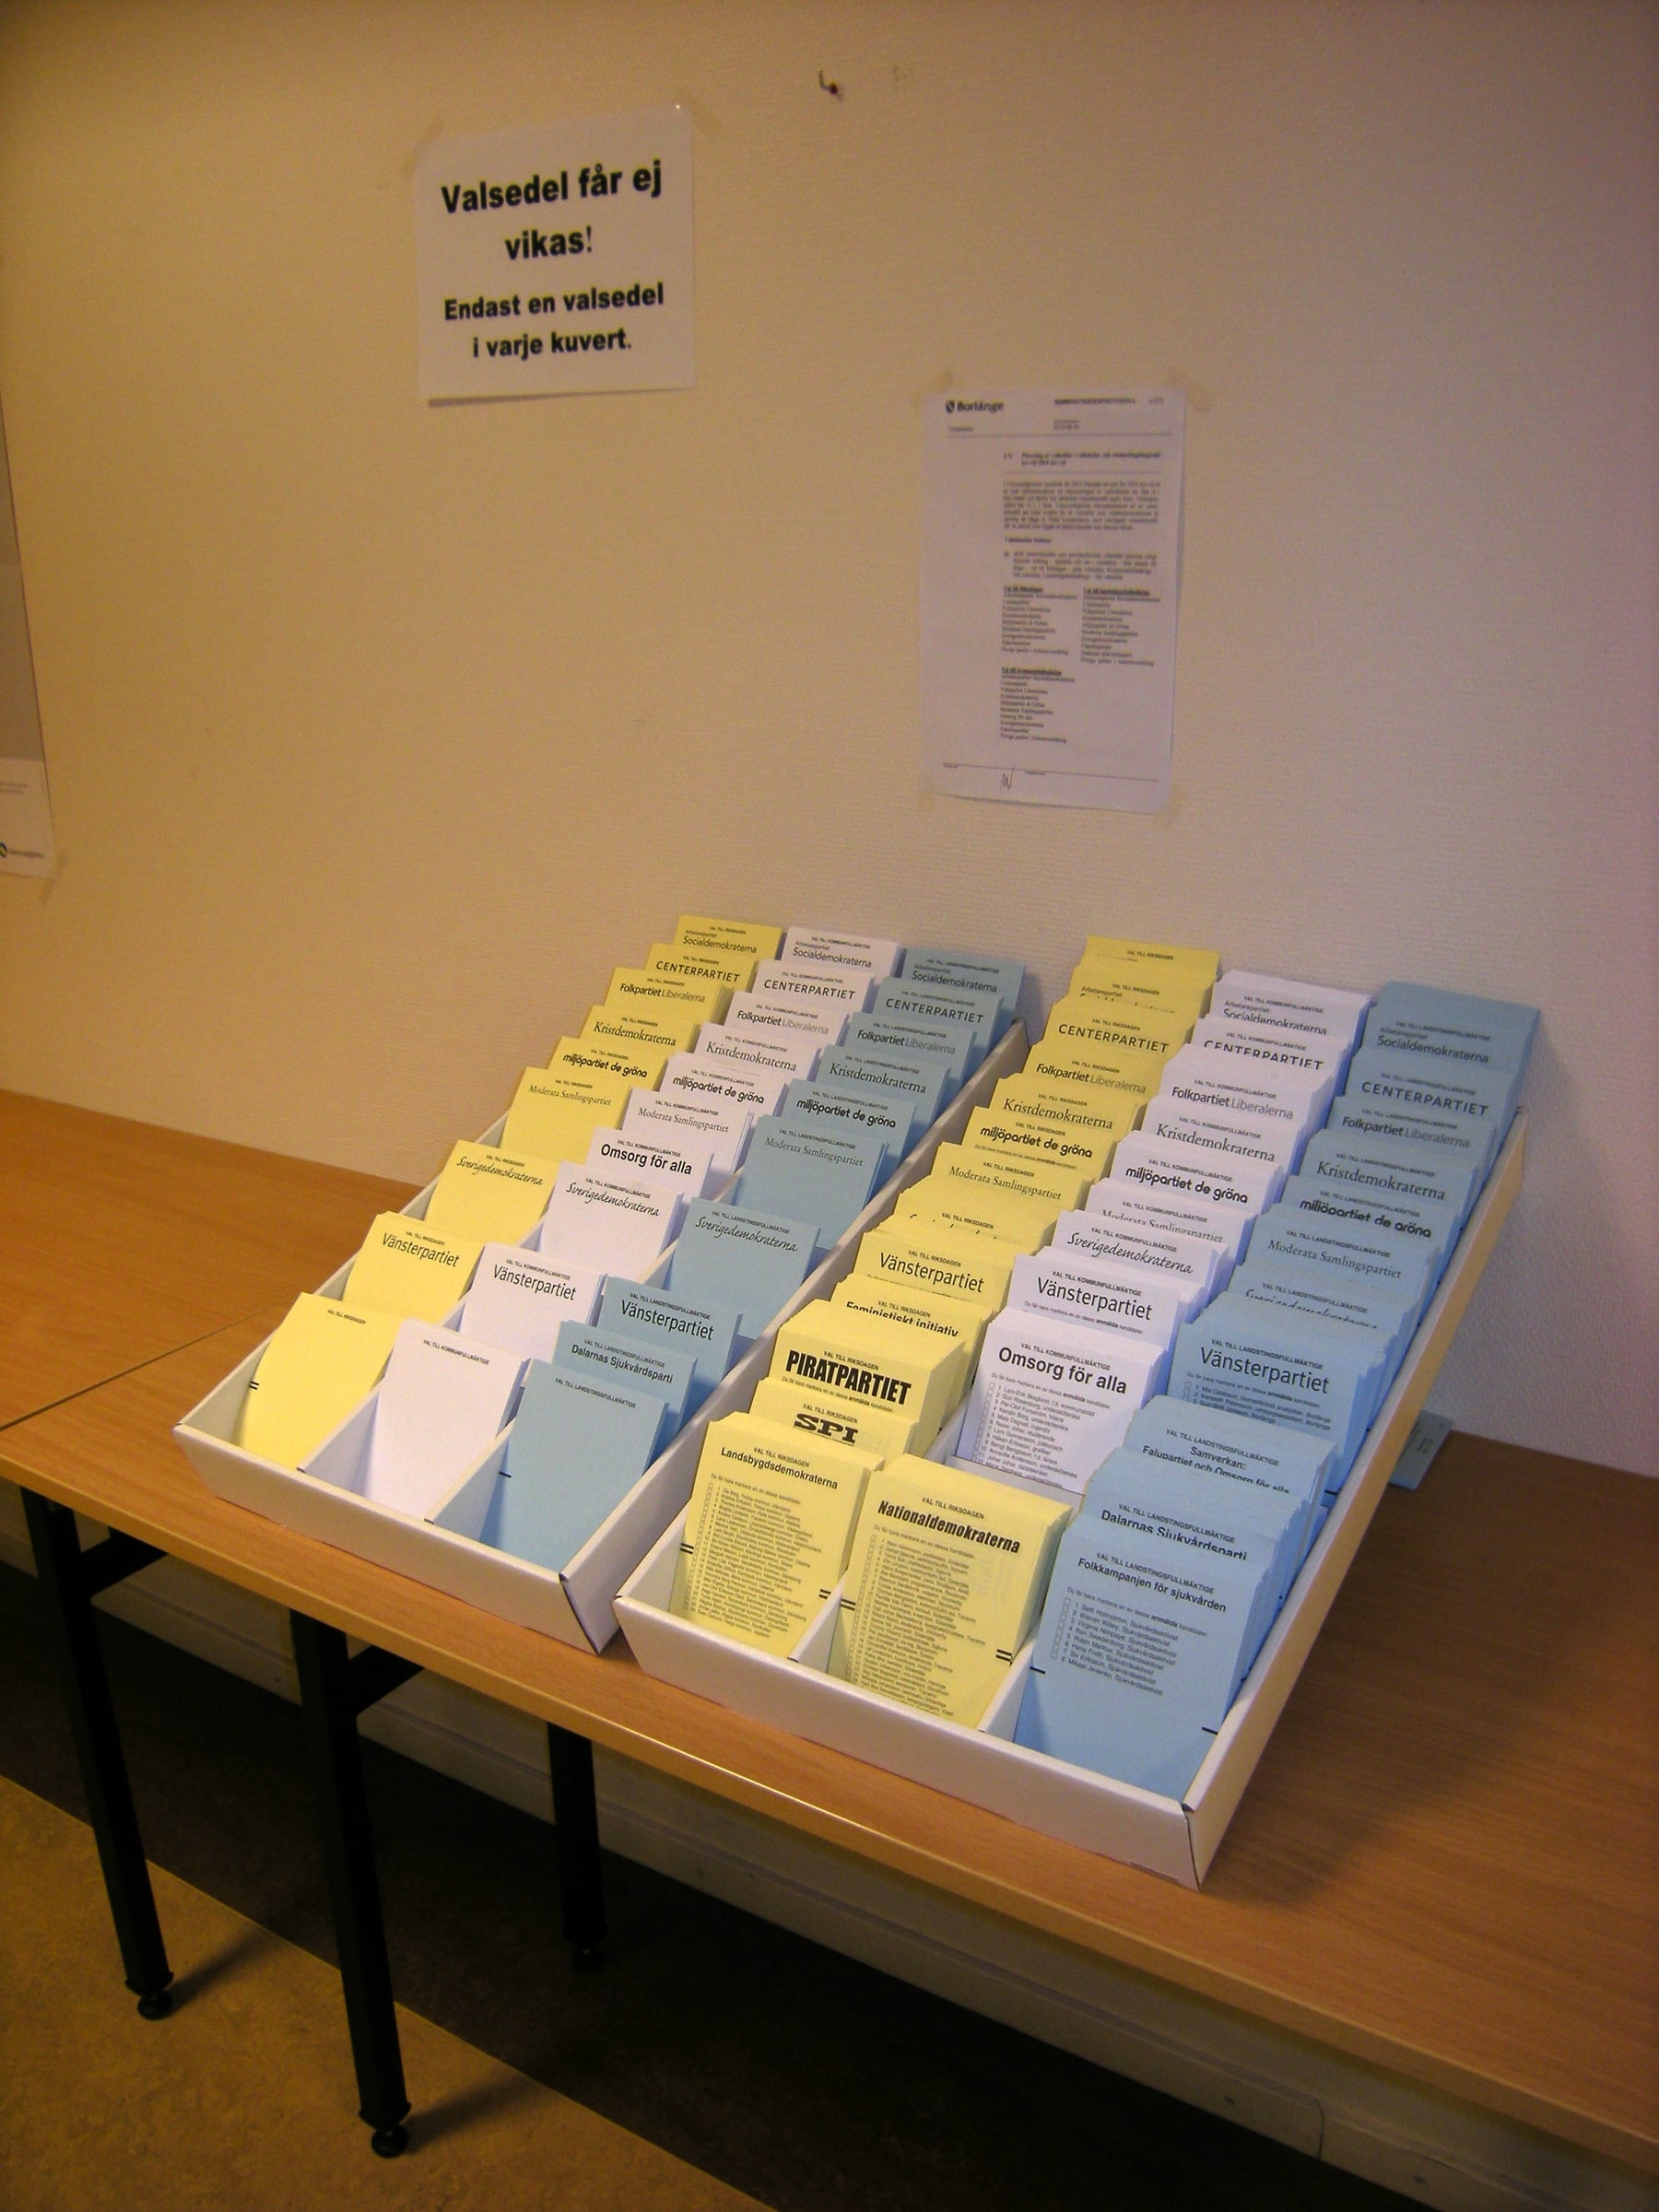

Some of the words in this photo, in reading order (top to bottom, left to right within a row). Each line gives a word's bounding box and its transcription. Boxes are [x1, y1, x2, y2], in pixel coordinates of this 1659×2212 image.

[441, 171, 569, 214] Valsedel
[579, 163, 622, 197] får
[632, 159, 662, 197] ej
[505, 226, 592, 260] vikas!
[444, 295, 520, 320] Endast
[529, 296, 555, 313] en
[563, 282, 664, 311] valsedel
[473, 337, 478, 357] i
[487, 334, 543, 360] varje
[551, 327, 631, 353] kuvert.
[683, 935, 757, 954] Socialdemokraterna
[793, 947, 872, 968] Socialdemokraterna
[655, 960, 740, 982] CENTERPARTIET
[912, 971, 997, 993] Socialdemokraterna
[764, 979, 855, 1000] CENTERPARTIET
[886, 998, 984, 1023] CENTERPARTIET
[594, 1021, 677, 1046] Kristdemokraterna
[1058, 1023, 1170, 1053] CENTERPARTIET
[1377, 1034, 1489, 1064] Socialdemokraterna
[610, 1061, 621, 1072] de
[622, 1066, 648, 1077] gröna
[706, 1041, 796, 1072] Kristdemokraterna
[830, 1063, 927, 1094] Kristdemokraterna
[529, 1084, 559, 1097] Moderata
[560, 1090, 611, 1106] Samlingspartiet
[724, 1086, 736, 1098] de
[737, 1090, 765, 1104] gröna
[1361, 1081, 1488, 1116] CENTERPARTIET
[638, 1107, 672, 1122] Moderata
[674, 1113, 729, 1134] Samlingspartiet
[796, 1098, 851, 1118] miljöpartiet
[853, 1109, 865, 1122] de
[867, 1114, 896, 1128] gröna
[1003, 1098, 1113, 1130] Kristdemokraterna
[765, 1137, 801, 1153] Moderata
[803, 1146, 863, 1167] Samlingspartiet
[981, 1126, 1041, 1147] miljöpartiet
[1044, 1138, 1058, 1150] de
[1060, 1143, 1092, 1158] gröna
[1157, 1123, 1275, 1163] Kristdemokraterna
[457, 1157, 544, 1186] Sverigedemokraterna
[601, 1143, 647, 1167] Omsorg
[651, 1154, 665, 1170] för
[670, 1161, 692, 1176] alla
[949, 1166, 991, 1183] Moderata
[993, 1175, 1061, 1200] Samlingspartiet
[1125, 1166, 1192, 1191] miljöpartiet
[1194, 1182, 1211, 1195] de
[1213, 1187, 1248, 1204] gröna
[1317, 1160, 1444, 1201] Kristdemokraterna
[566, 1182, 660, 1217] Sverigedemokraterna
[695, 1216, 798, 1252] Sverigedemokraterna
[1374, 1215, 1391, 1229] de
[382, 1232, 460, 1267] Vänsterpartiet
[1067, 1232, 1194, 1275] Sverigedemokraterna
[1268, 1240, 1317, 1261] Moderata
[1320, 1251, 1402, 1279] Samlingspartiet
[493, 1264, 577, 1301] Vänsterpartiet
[880, 1252, 985, 1293] Vänsterpartiet
[1038, 1277, 1152, 1321] Vänsterpartiet
[621, 1299, 714, 1340] Vänsterpartiet
[571, 1344, 608, 1364] Dalarnas
[610, 1357, 673, 1383] Sjukvårdsparti
[785, 1349, 912, 1405] PIRATPARTIET
[998, 1347, 1064, 1380] Omsorg
[1068, 1365, 1092, 1384] för
[1096, 1374, 1126, 1394] alla
[1200, 1347, 1329, 1394] Vänsterpartiet
[794, 1413, 858, 1443] SPI
[1165, 1430, 1178, 1438] VAL
[721, 1446, 839, 1489] Landsbygdsdemokraterna
[1190, 1446, 1246, 1471] Samverkan:
[921, 1497, 933, 1506] VAL
[935, 1500, 947, 1510] TILL
[947, 1504, 984, 1519] RIKSDAGEN
[1101, 1509, 1153, 1534] Dalarnas
[1117, 1504, 1130, 1513] VAL
[877, 1500, 1020, 1554] Nationaldemokraterna
[1095, 1552, 1109, 1561] VAL
[1078, 1557, 1151, 1590] Folkkampanjen
[1154, 1583, 1168, 1594] för
[1170, 1588, 1226, 1613] sjukvården
